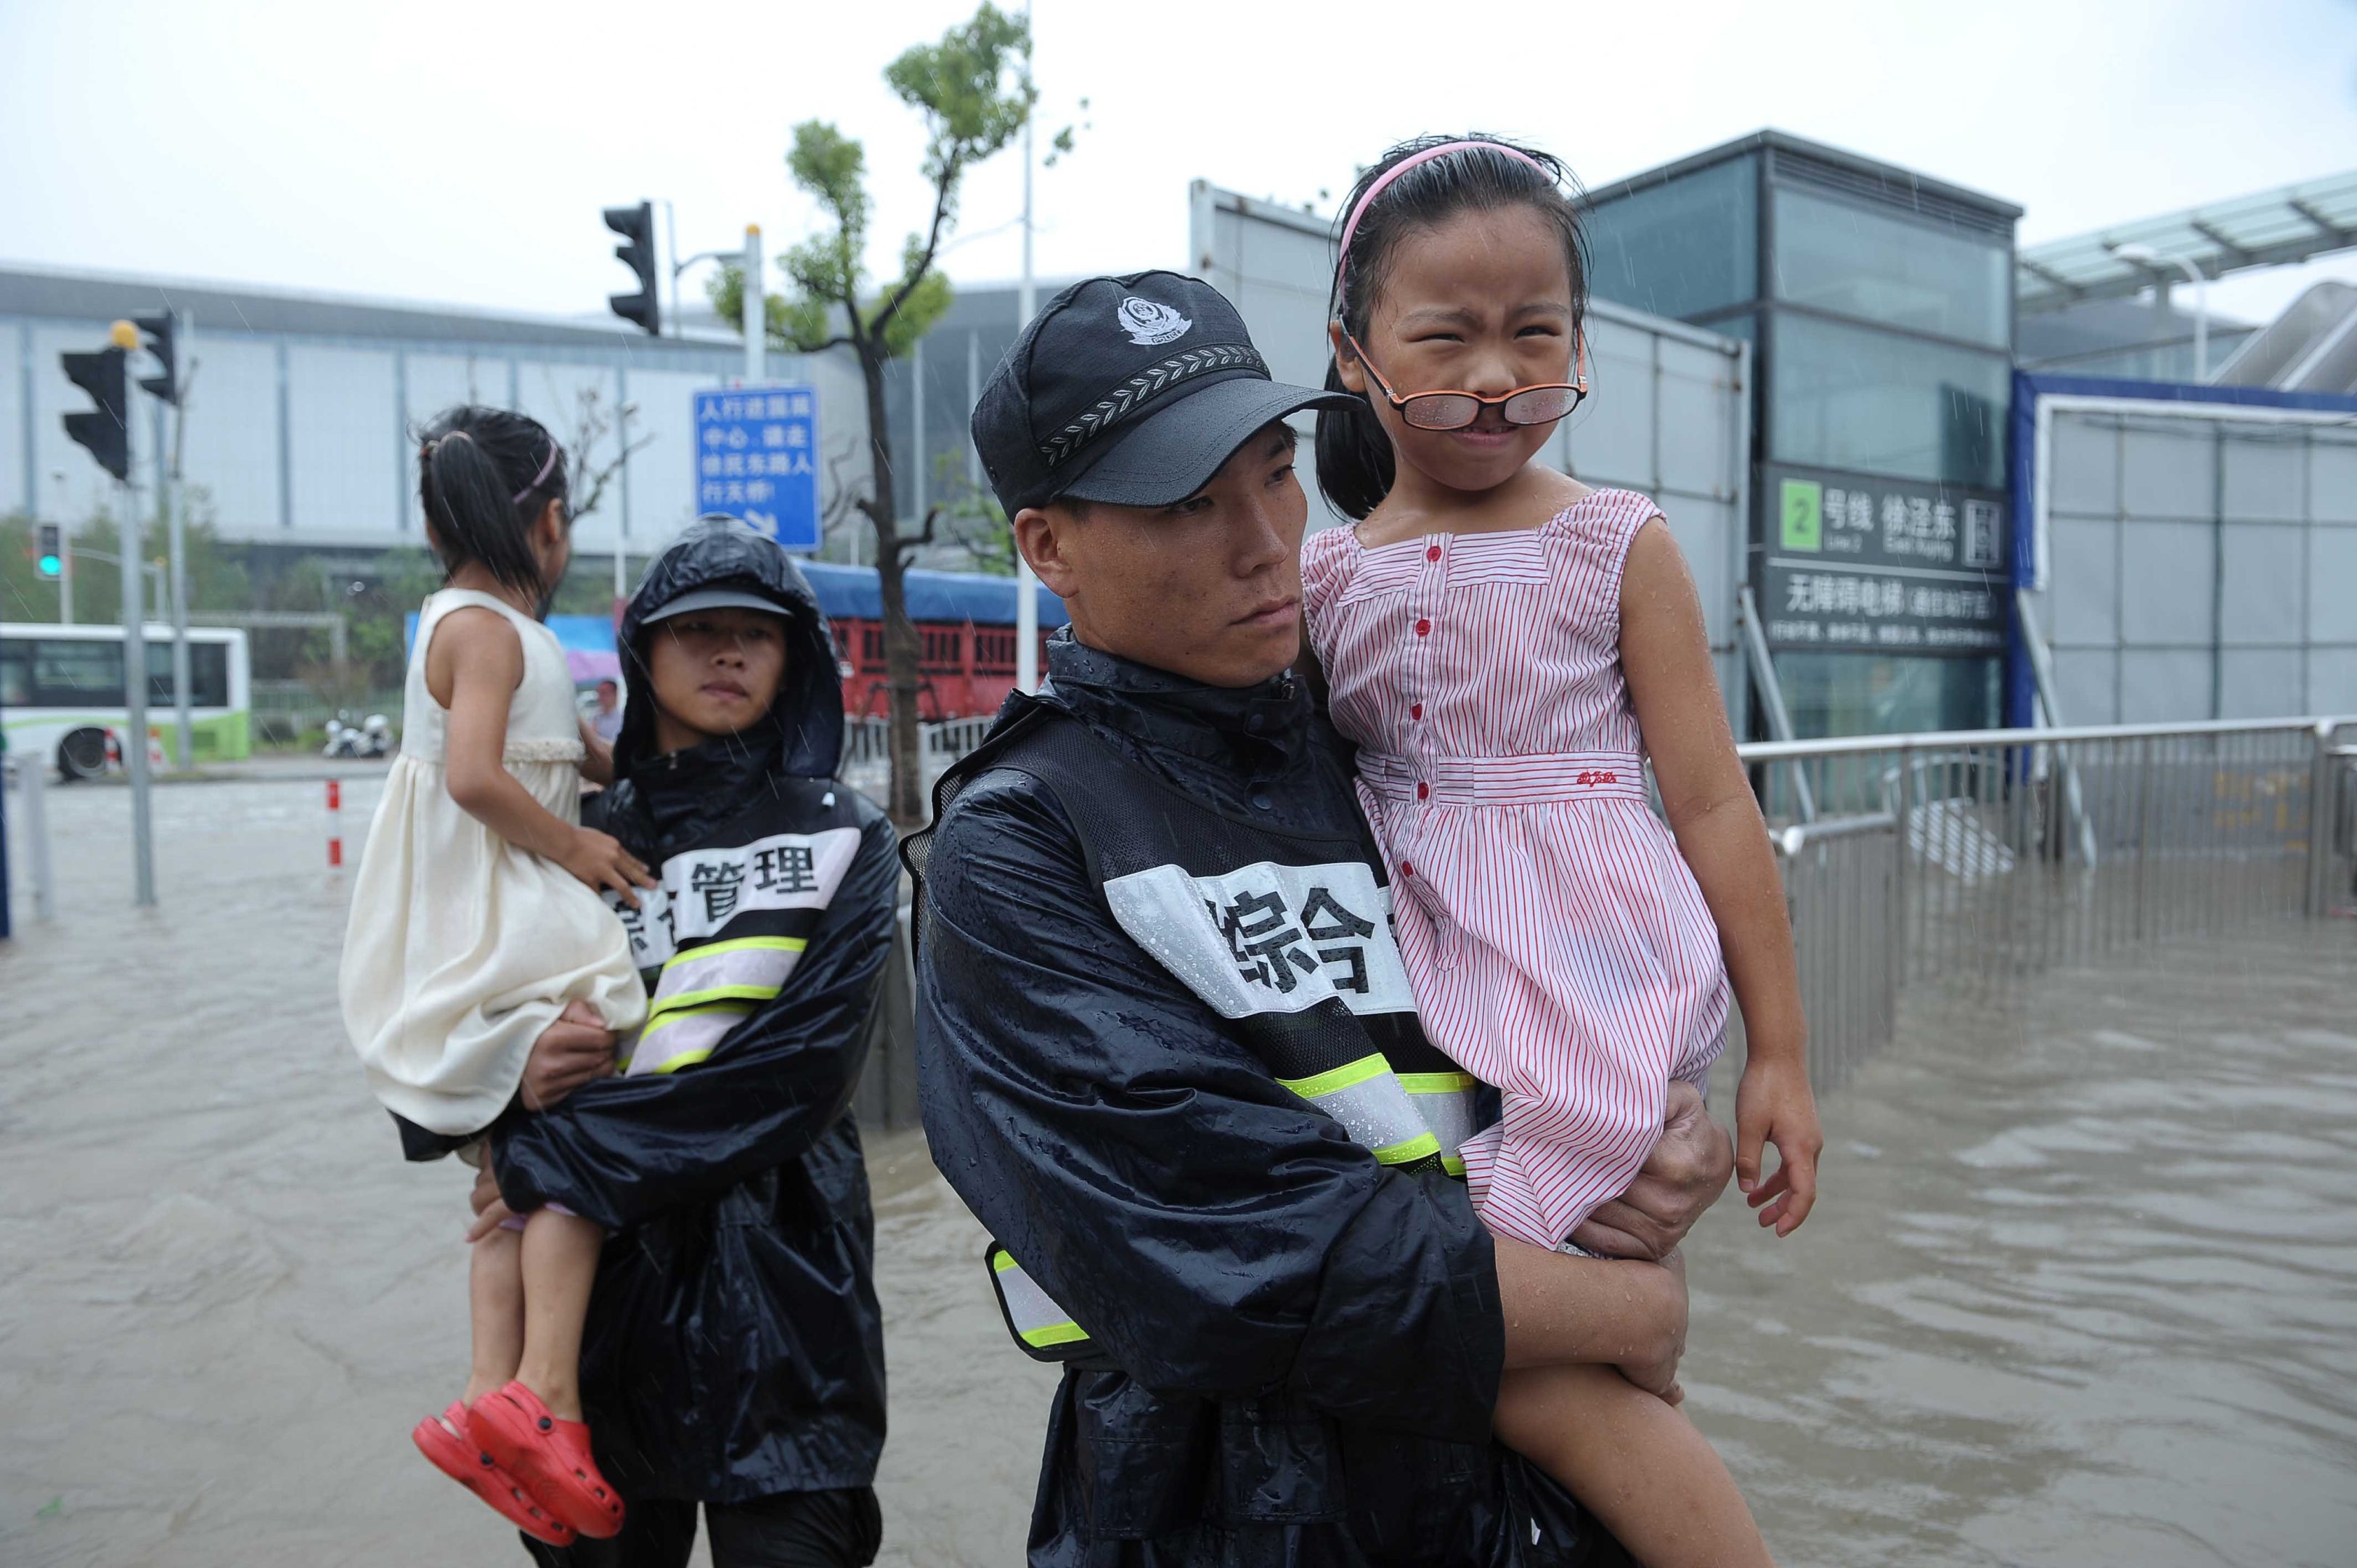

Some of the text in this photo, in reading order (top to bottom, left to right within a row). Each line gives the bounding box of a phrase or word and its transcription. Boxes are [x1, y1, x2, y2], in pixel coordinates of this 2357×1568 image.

[1792, 489, 1955, 539] 2 号线 徐泾东
[1204, 887, 1375, 994] 综合
